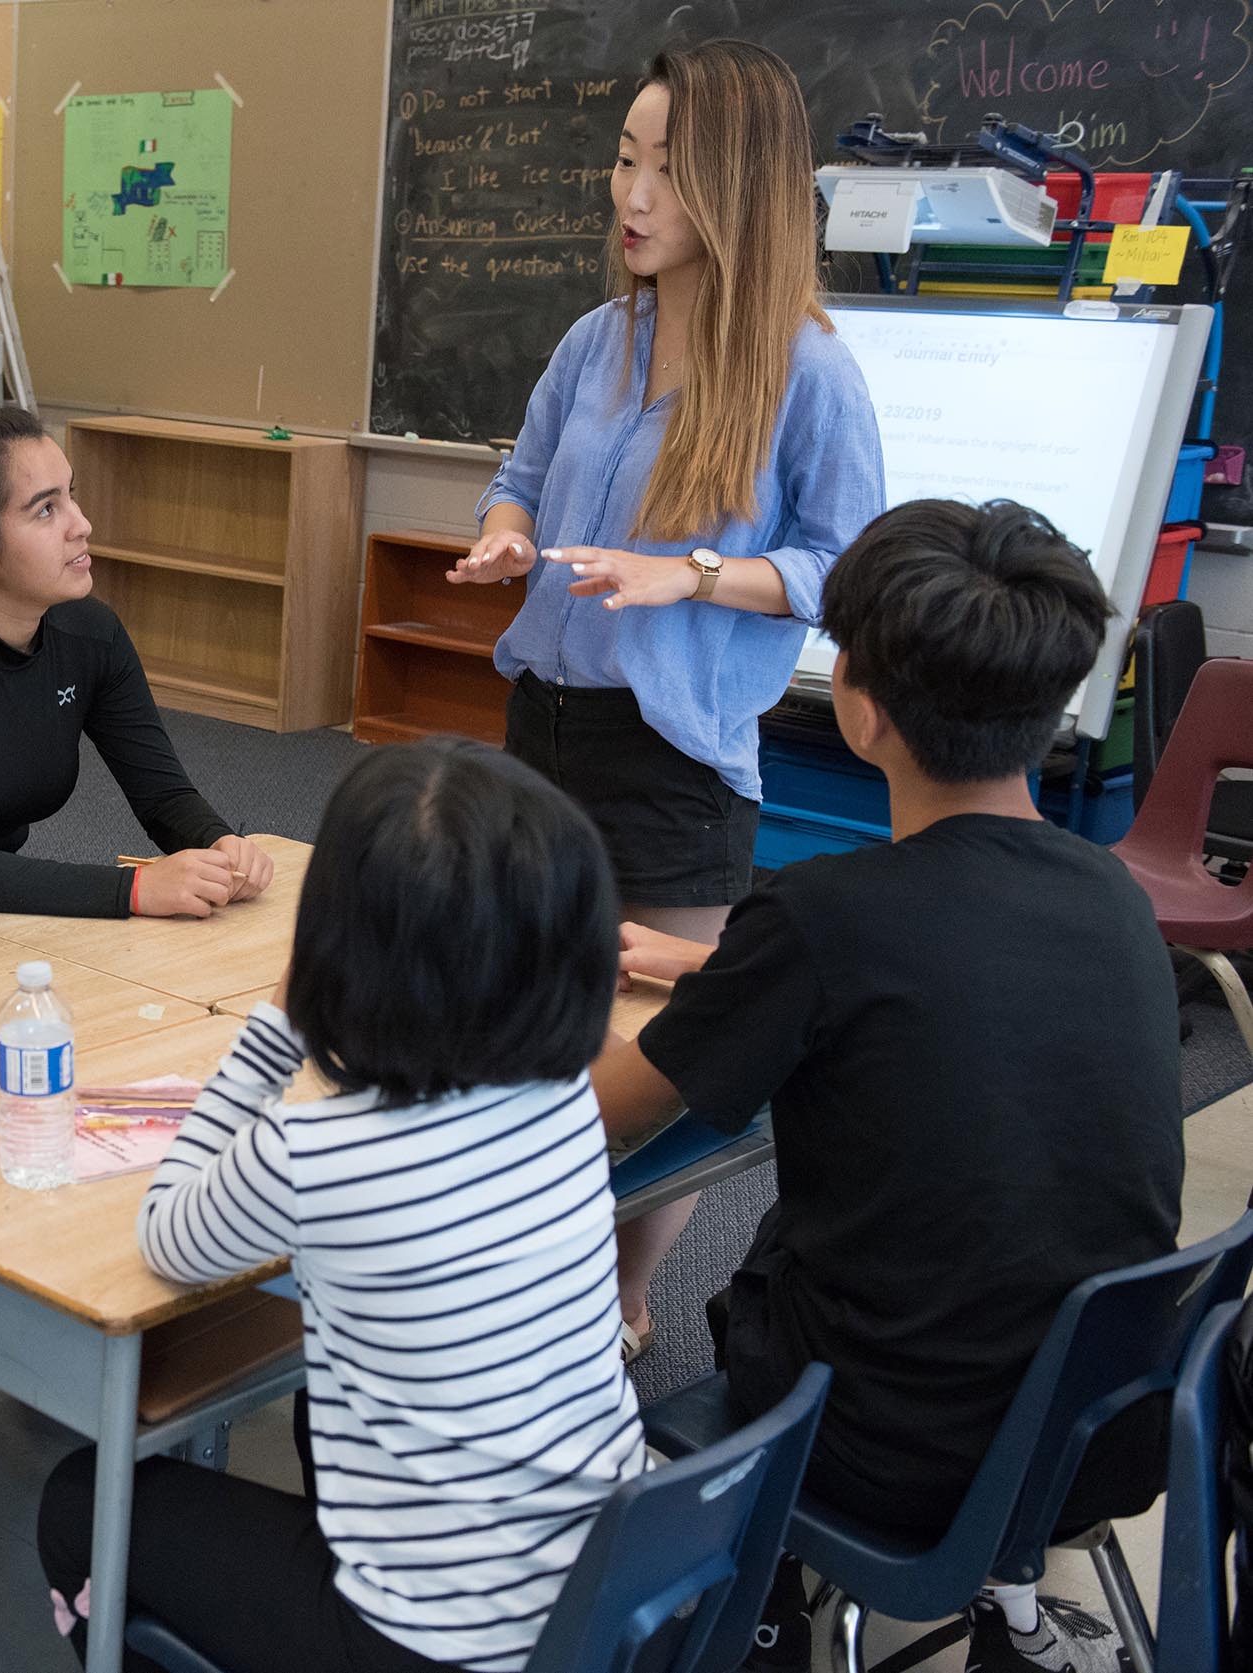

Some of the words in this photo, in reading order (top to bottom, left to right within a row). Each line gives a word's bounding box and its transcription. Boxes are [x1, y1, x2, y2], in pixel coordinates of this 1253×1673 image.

[958, 36, 1109, 98] Welcome
[423, 89, 446, 113] Do
[459, 85, 492, 108] not
[504, 77, 553, 105] start
[573, 78, 619, 106] your
[439, 168, 458, 192] I
[467, 165, 501, 190] like
[522, 164, 550, 185] ice
[415, 212, 497, 246] Answering
[513, 208, 603, 233] Questions
[850, 210, 888, 219] HITACHI
[441, 255, 472, 278] the
[485, 254, 564, 282] question
[575, 251, 599, 275] to
[893, 348, 953, 361] Journal
[884, 405, 942, 421] 23/2019
